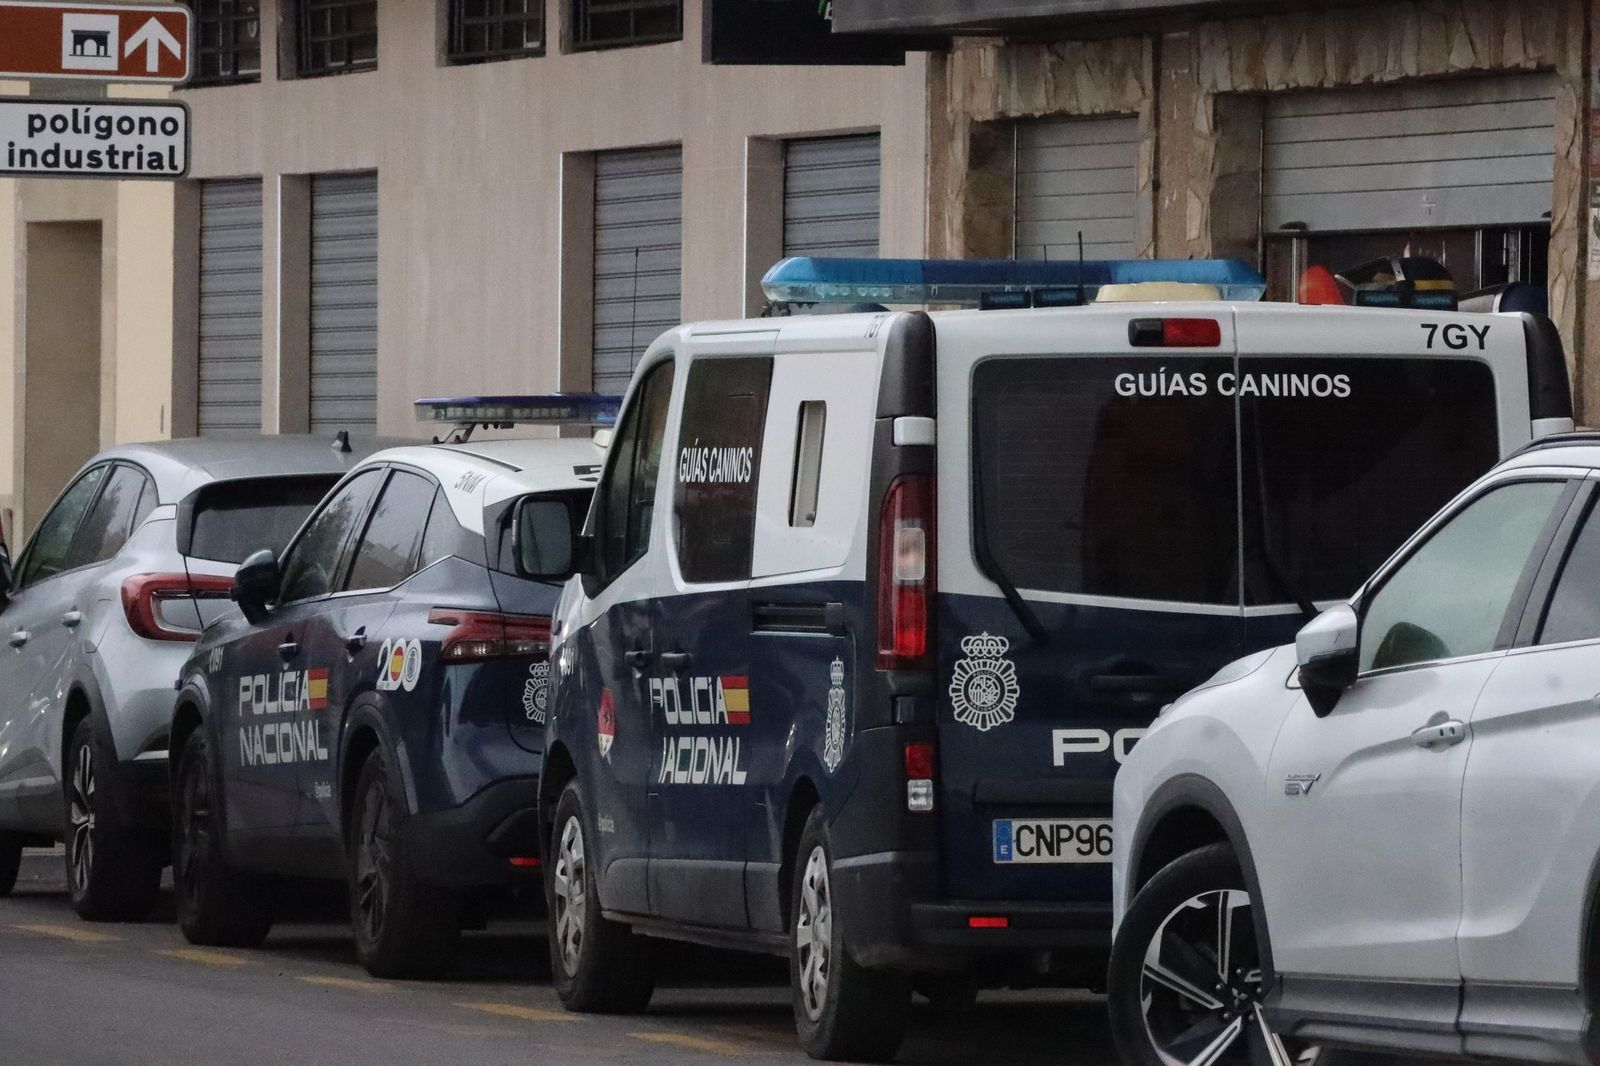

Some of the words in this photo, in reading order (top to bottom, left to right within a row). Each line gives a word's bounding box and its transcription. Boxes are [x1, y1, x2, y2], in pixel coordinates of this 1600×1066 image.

[27, 107, 179, 140] polígono
[8, 141, 178, 171] industrial
[1420, 323, 1491, 350] 7GY
[1114, 367, 1208, 397] GUÍAS
[1216, 372, 1351, 398] CANINOS
[680, 437, 709, 483] GUÍAS
[709, 446, 753, 483] CANINOS
[376, 637, 422, 692] 200
[239, 669, 311, 717] POLICÍA
[240, 720, 329, 767] NACIONAL
[1000, 845, 1009, 855] E
[1015, 824, 1113, 857] CNP96
